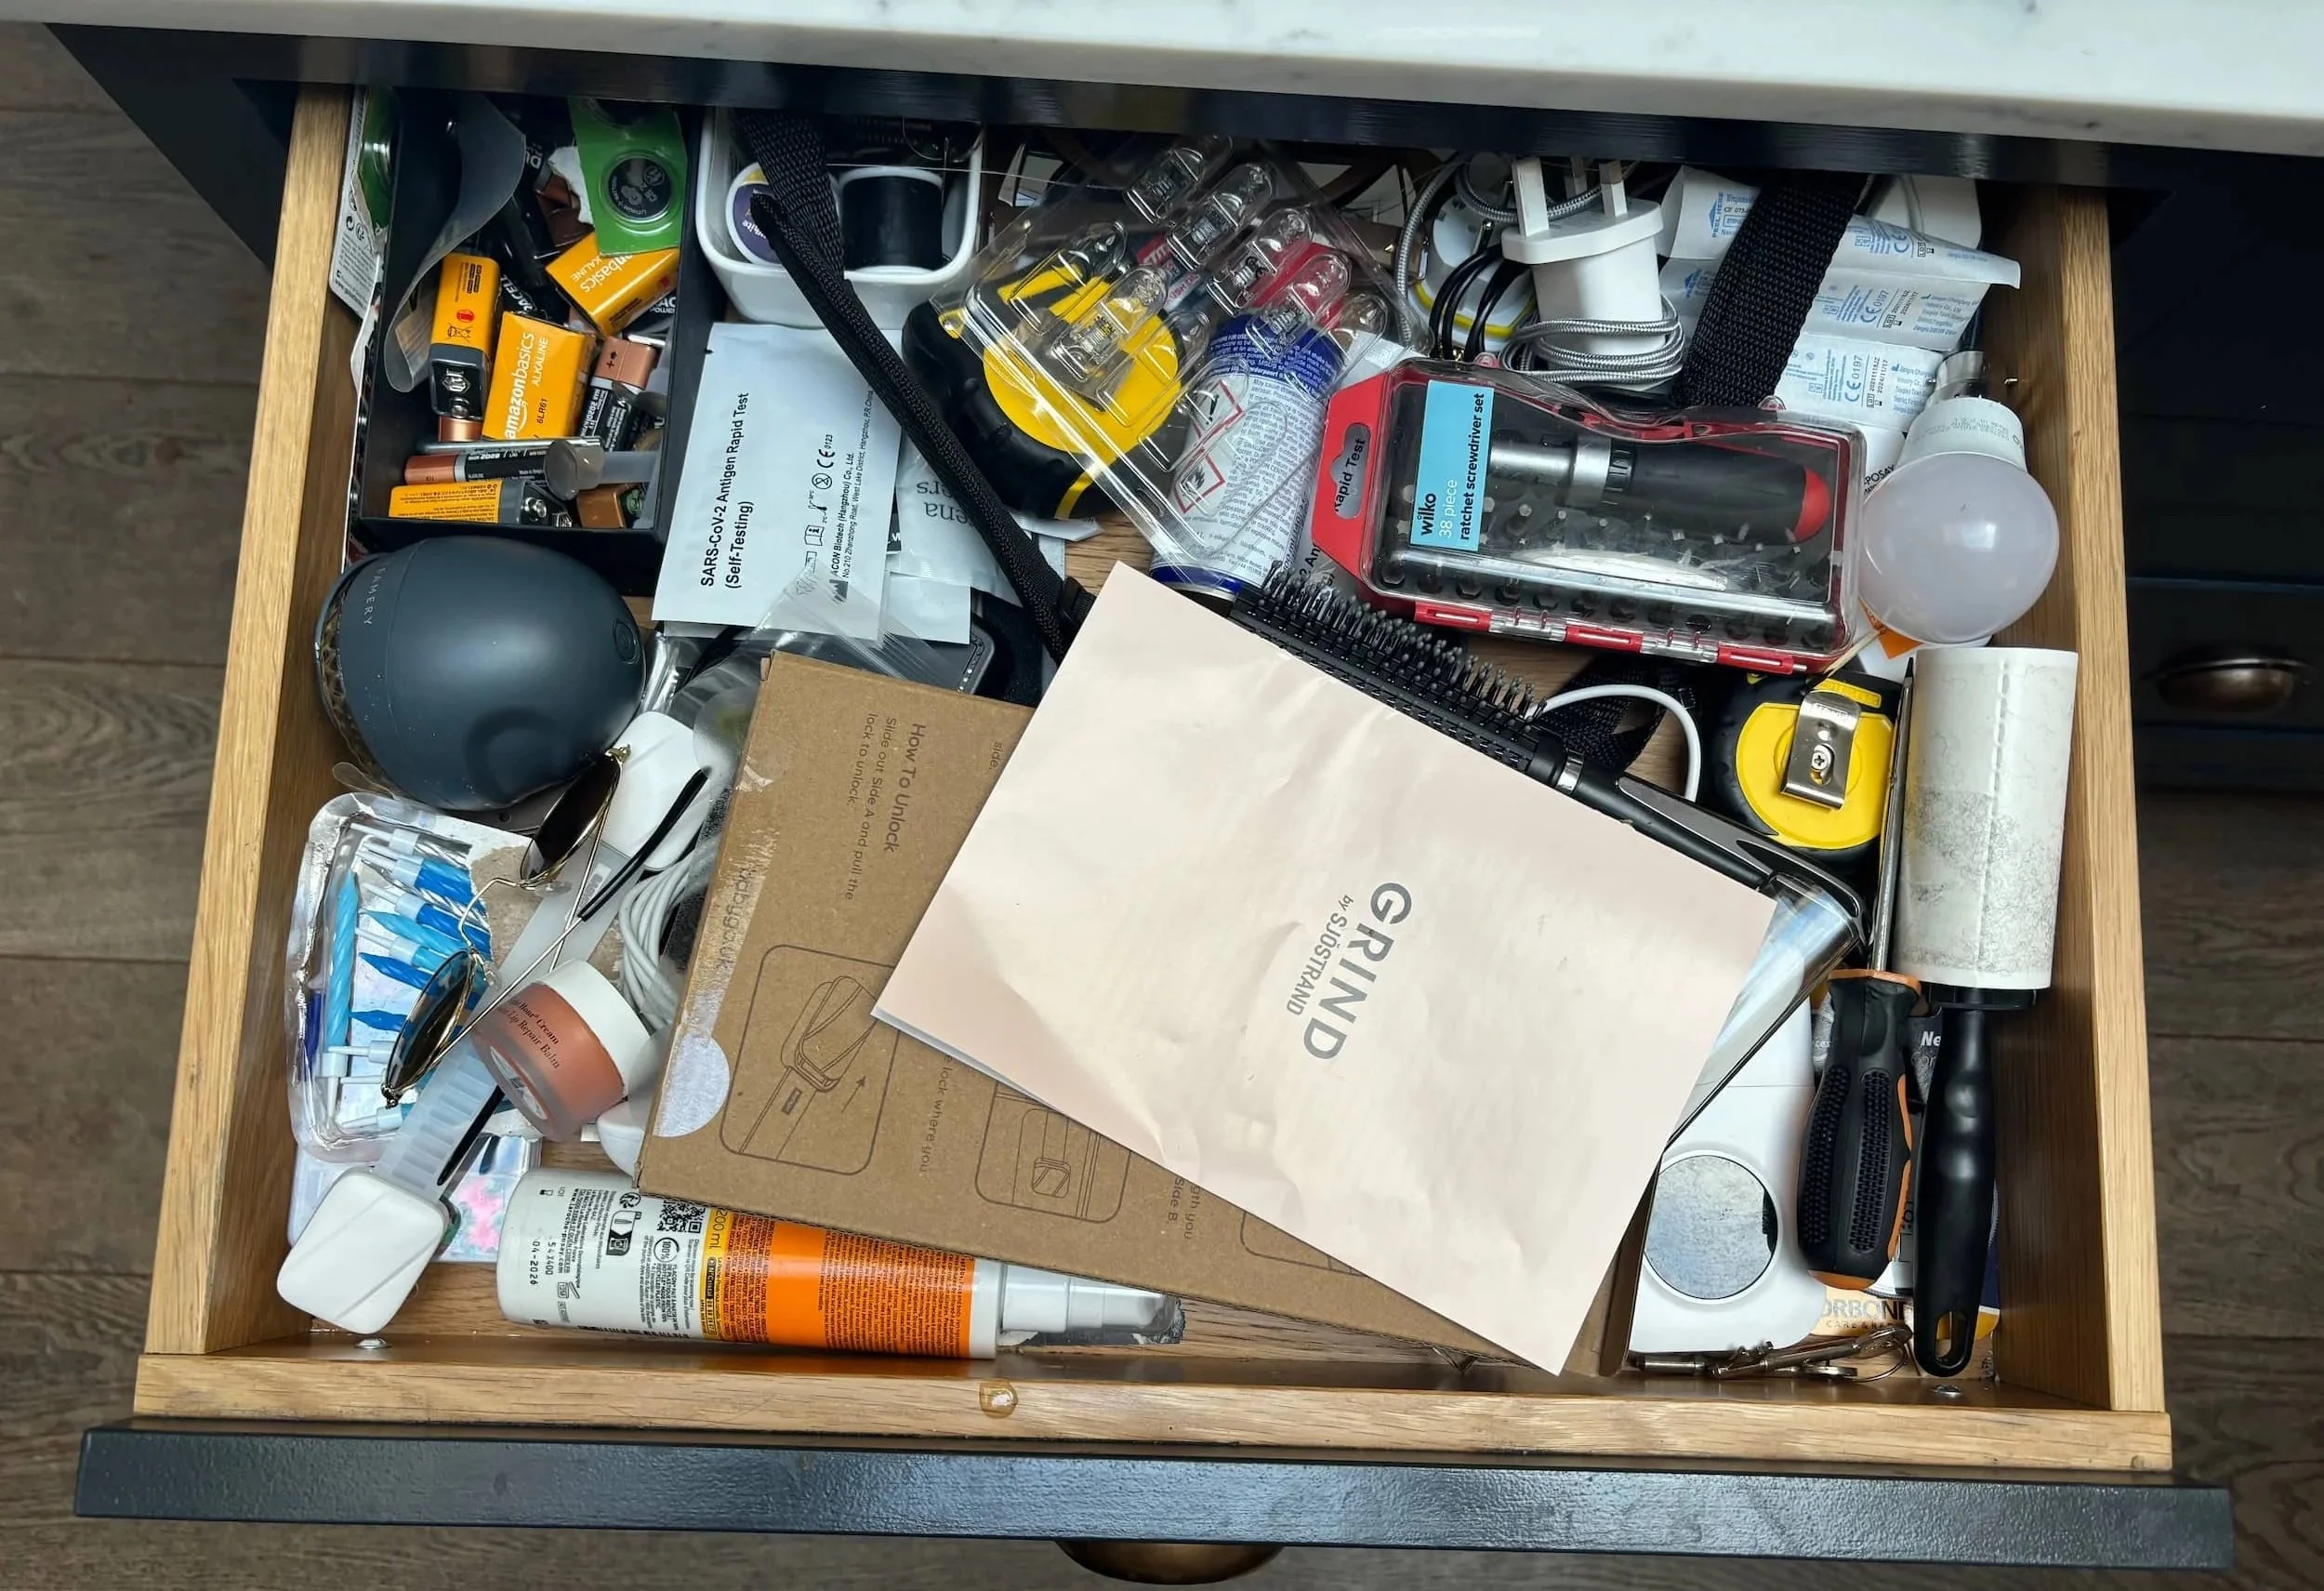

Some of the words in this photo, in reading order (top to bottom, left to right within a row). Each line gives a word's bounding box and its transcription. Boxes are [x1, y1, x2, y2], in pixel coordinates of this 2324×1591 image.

[571, 256, 602, 282] KALINE
[532, 337, 549, 387] ALKALINE
[1851, 354, 1862, 379] 0197
[505, 331, 535, 439] amazonbasics
[537, 398, 548, 424] 6LR61
[733, 392, 749, 418] Test
[1473, 393, 1485, 414] set
[727, 419, 744, 457] Rapid
[824, 433, 833, 449] 0123
[1347, 438, 1366, 469] Test
[1467, 417, 1482, 490] screwdriver
[717, 457, 736, 503] Antigen
[838, 481, 852, 521] (Hangzhou)
[1445, 480, 1458, 516] piece
[1418, 493, 1436, 536] wilko
[1460, 493, 1473, 540] ratchet
[833, 522, 844, 550] Biotech
[1440, 520, 1453, 538] 38
[701, 505, 727, 587] SARS-CoV-2
[725, 501, 754, 589] (Self-Testing)
[830, 551, 840, 577] ACON
[862, 712, 878, 740] lock
[880, 715, 898, 749] Slide
[858, 743, 870, 758] to
[904, 723, 926, 762] How
[874, 750, 888, 774] out
[845, 760, 866, 807] unlock.
[897, 764, 917, 789] To
[866, 776, 883, 806] Side
[864, 808, 876, 818] A
[882, 792, 910, 854] Unlock
[857, 820, 874, 847] and
[849, 849, 866, 875] pull
[844, 877, 860, 901] the
[1340, 895, 1353, 911] by
[1286, 912, 1348, 1015] SJÖSTRAND
[1303, 882, 1412, 1059] GRIND
[535, 1017, 560, 1044] Cream
[540, 1041, 561, 1069] Balm
[935, 1067, 952, 1095] lock
[925, 1098, 944, 1142] where
[917, 1145, 932, 1172] you
[1186, 1185, 1203, 1209] gth
[558, 1187, 579, 1274] www.laroche-posay.com
[1181, 1213, 1196, 1240] you
[530, 1240, 541, 1286] 04-2026
[659, 1240, 672, 1261] 100%
